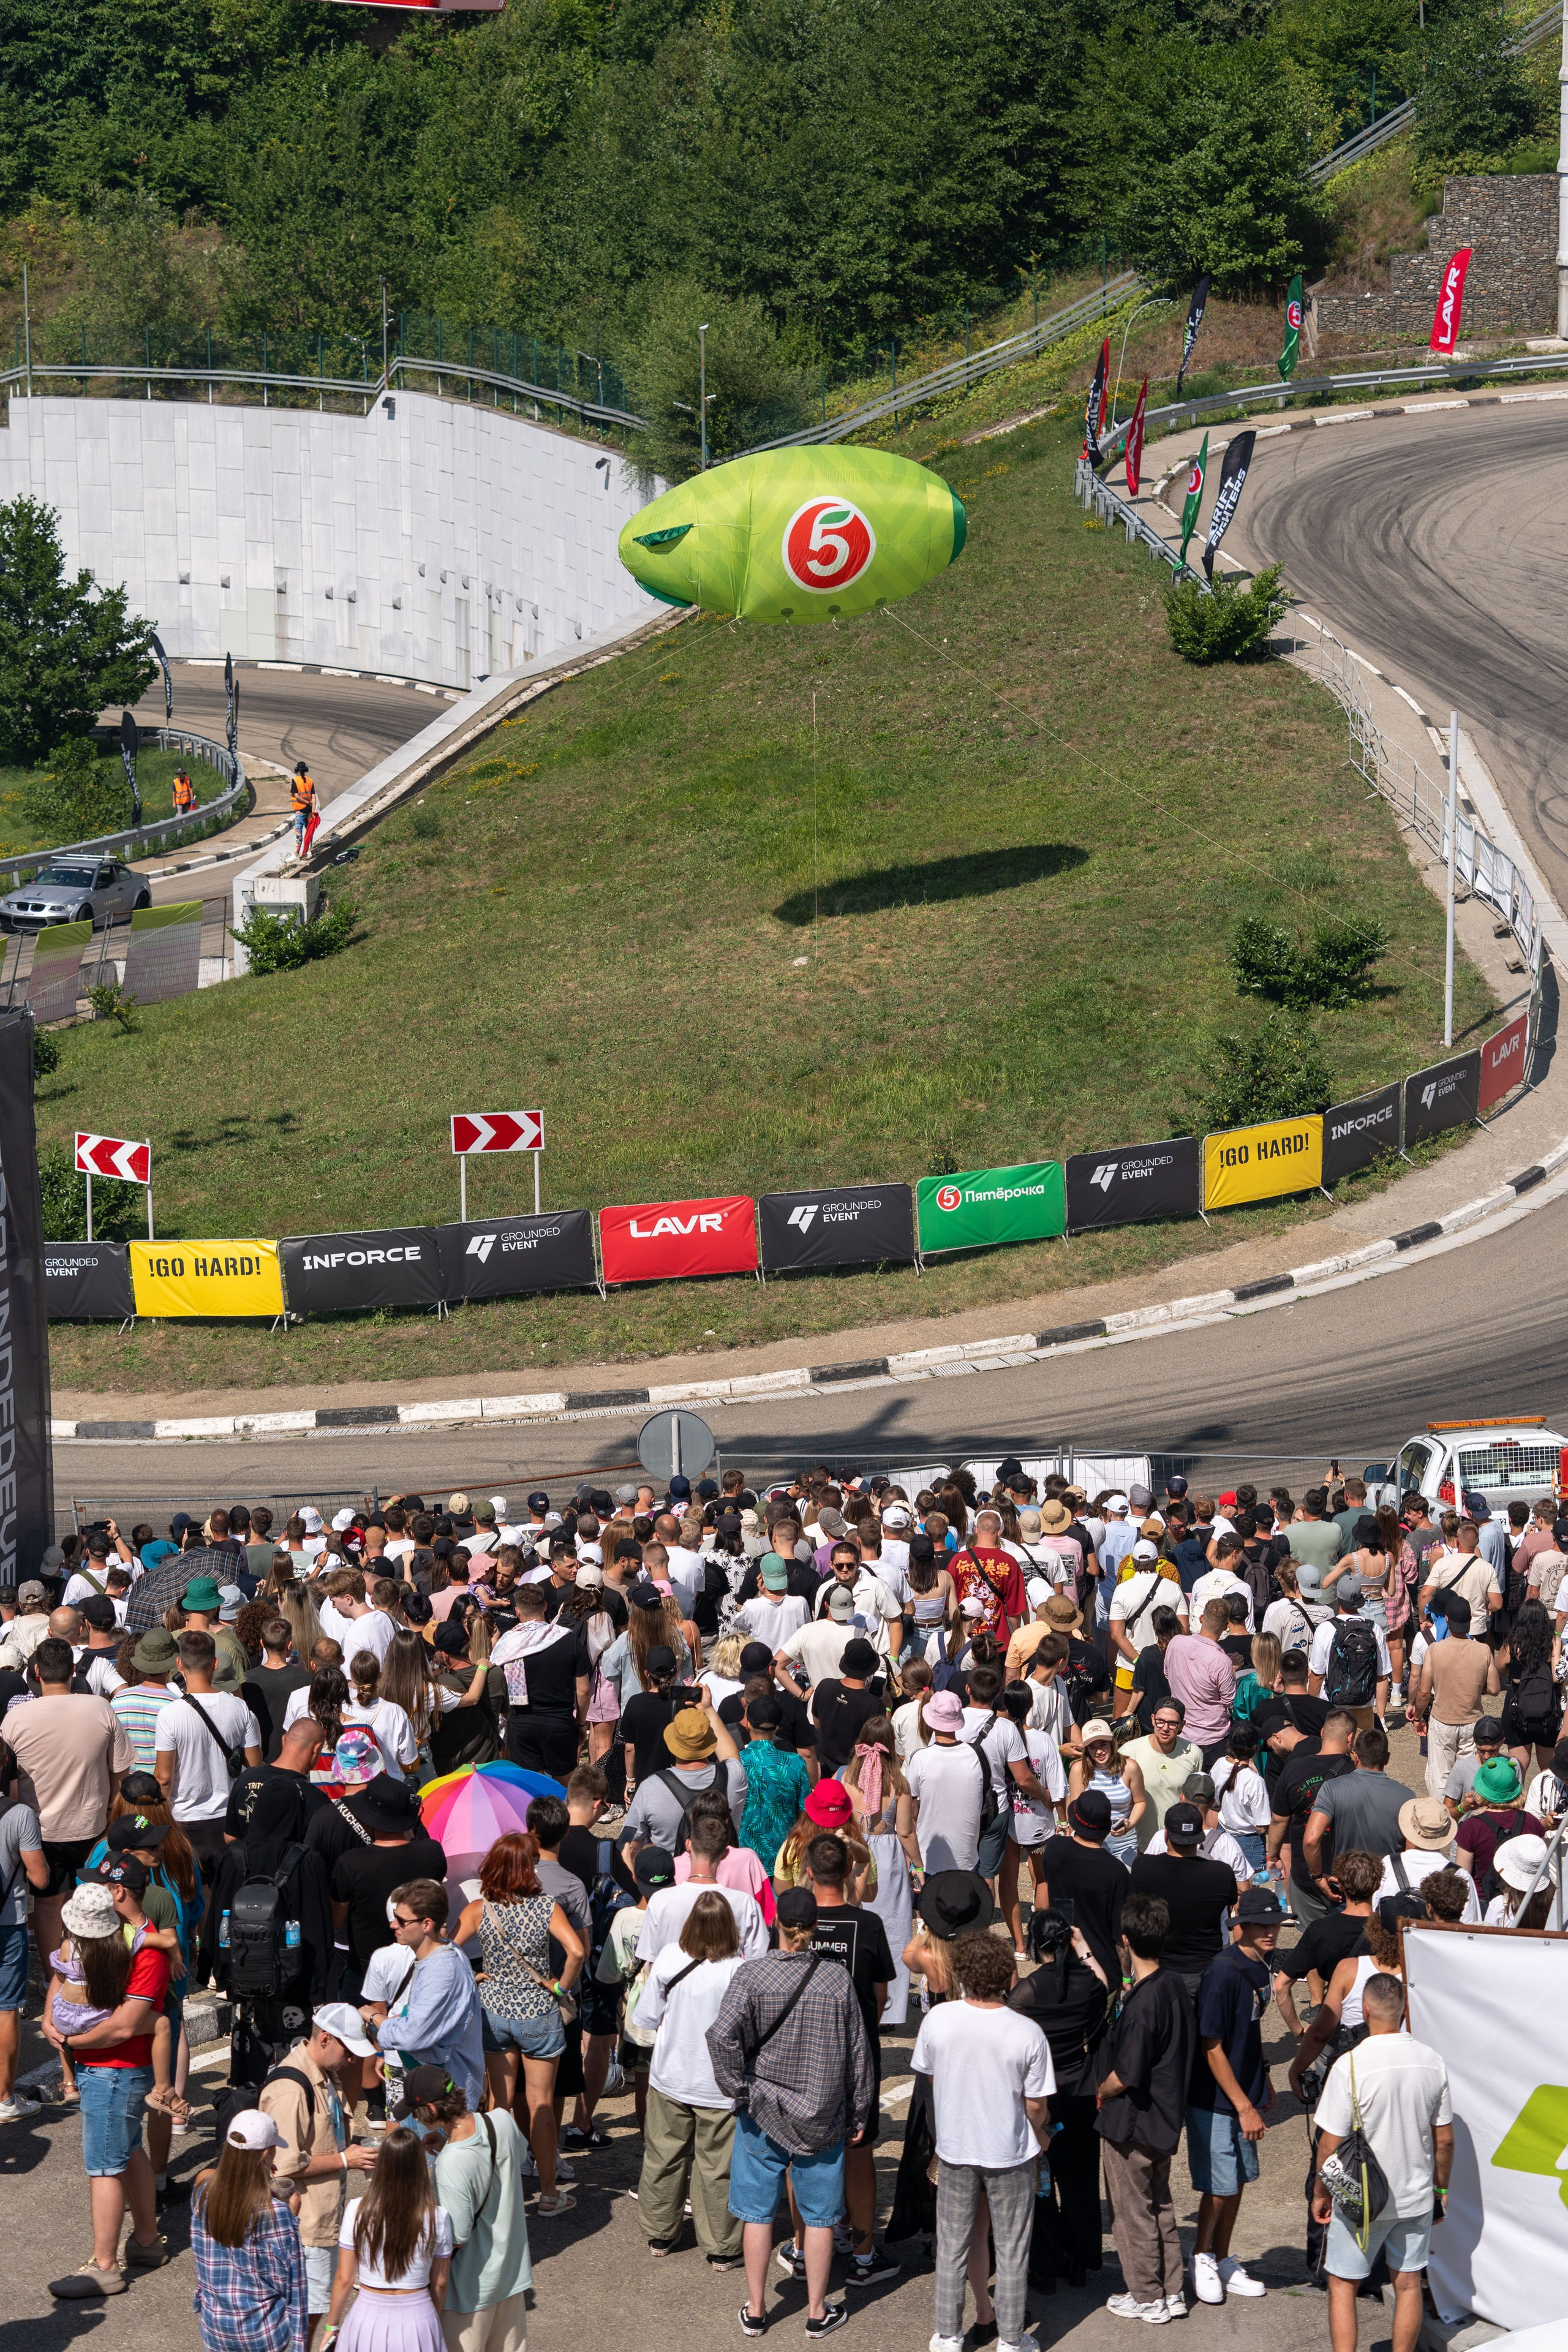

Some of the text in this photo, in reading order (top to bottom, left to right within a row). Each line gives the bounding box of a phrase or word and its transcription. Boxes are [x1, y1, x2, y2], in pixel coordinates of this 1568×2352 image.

[1439, 267, 1460, 344] LAVR
[1209, 476, 1235, 537] DRIFT
[807, 505, 856, 576] 5
[1492, 1033, 1520, 1068] LAVR
[1438, 1070, 1467, 1088] GROUNDED
[1438, 1083, 1456, 1096] EVENT
[1331, 1104, 1393, 1140] INFORCE
[1219, 1133, 1310, 1168] !GO HARD!
[1121, 1156, 1173, 1170] GROUNDED
[1121, 1167, 1153, 1180] EVENT
[965, 1185, 1044, 1203] Пятёрочка
[822, 1200, 881, 1212] GROUNDED
[630, 1213, 723, 1238] LAVR
[823, 1212, 859, 1223] EVENT
[500, 1227, 560, 1242] GROUNDED
[502, 1240, 538, 1252] EVENT
[45, 1257, 98, 1267] GROUNDED
[149, 1256, 261, 1277] !GO HARD!
[303, 1246, 421, 1270] INFORCE
[45, 1267, 78, 1276] EVENT
[1306, 1776, 1323, 1785] PIZZA
